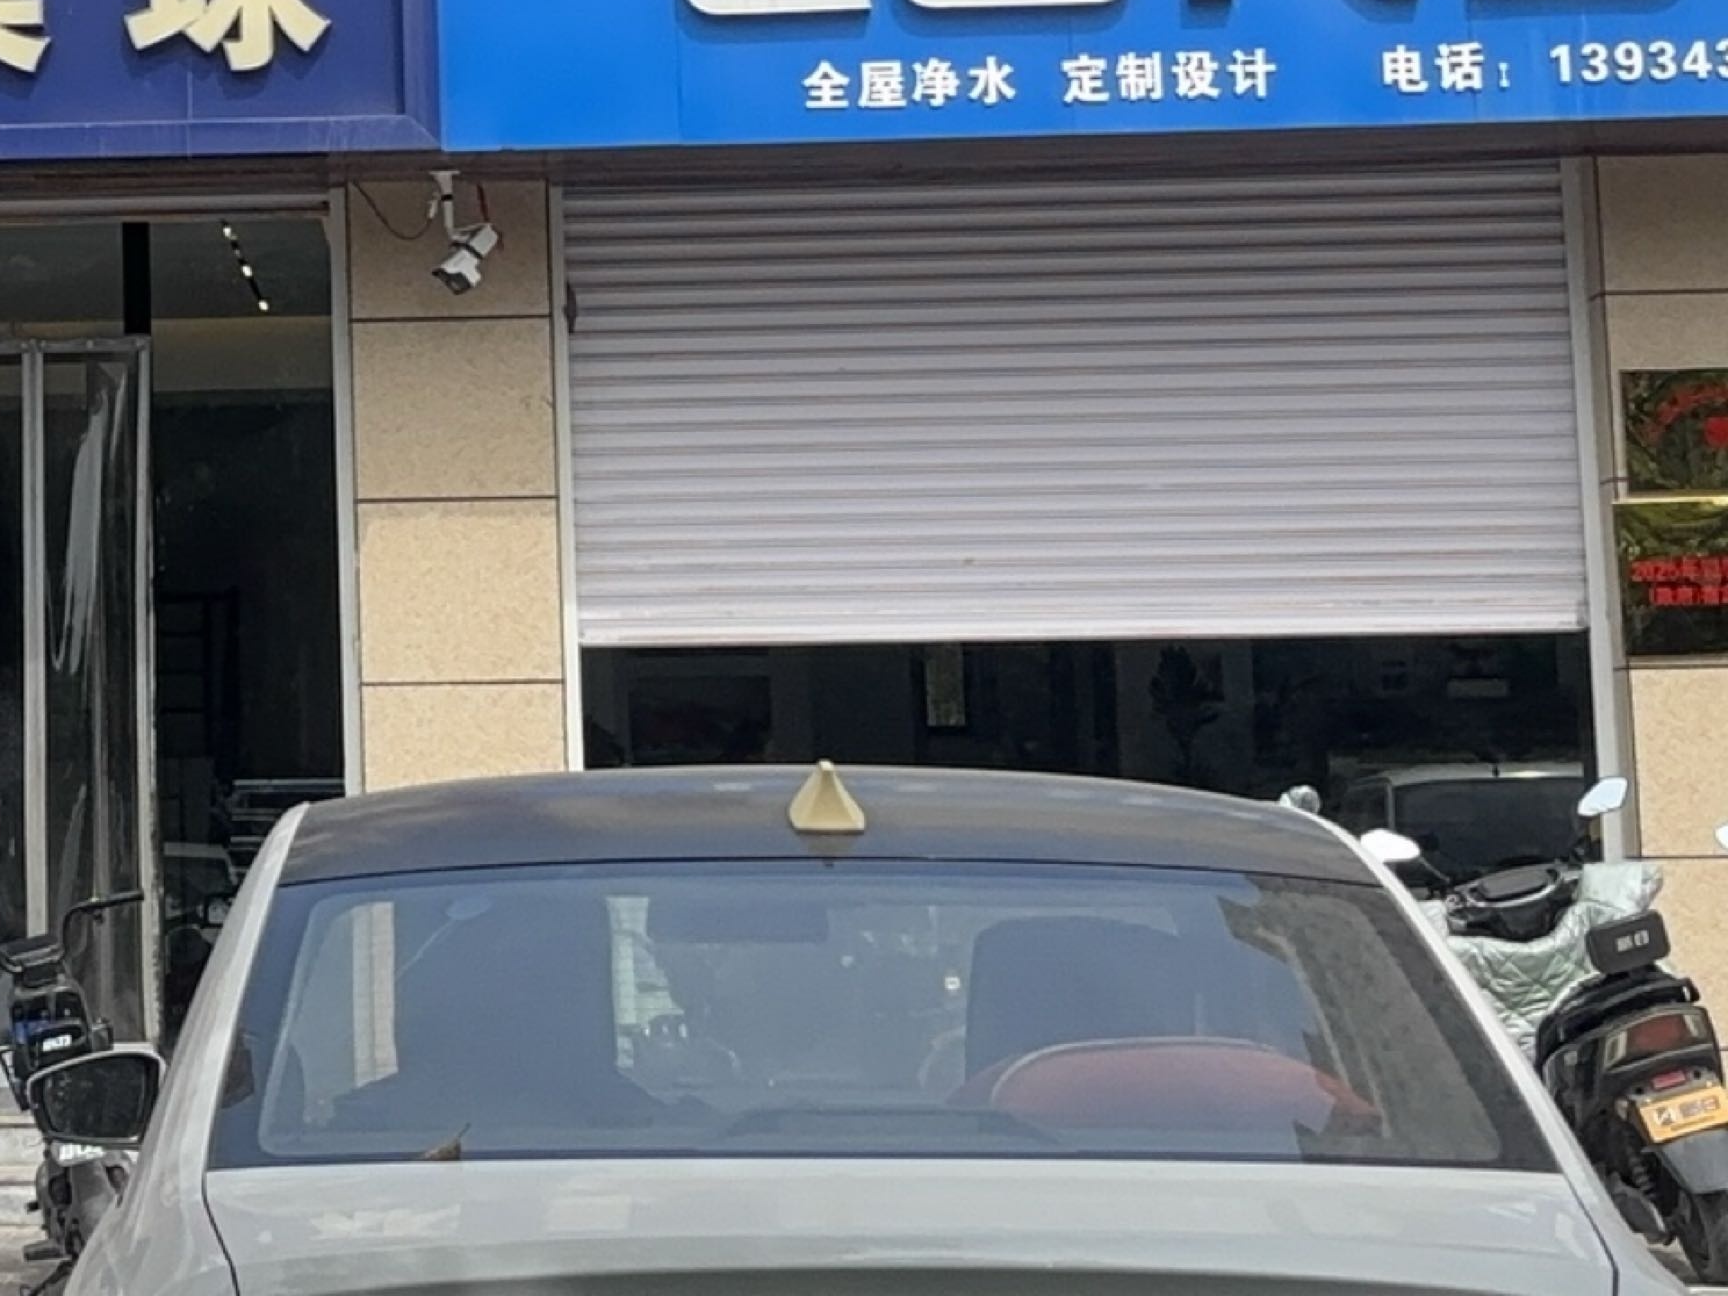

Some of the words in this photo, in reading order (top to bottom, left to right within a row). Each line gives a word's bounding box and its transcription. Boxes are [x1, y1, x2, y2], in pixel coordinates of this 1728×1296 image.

[802, 55, 1018, 109] 全屋净水
[1060, 47, 1278, 103] 定制设计
